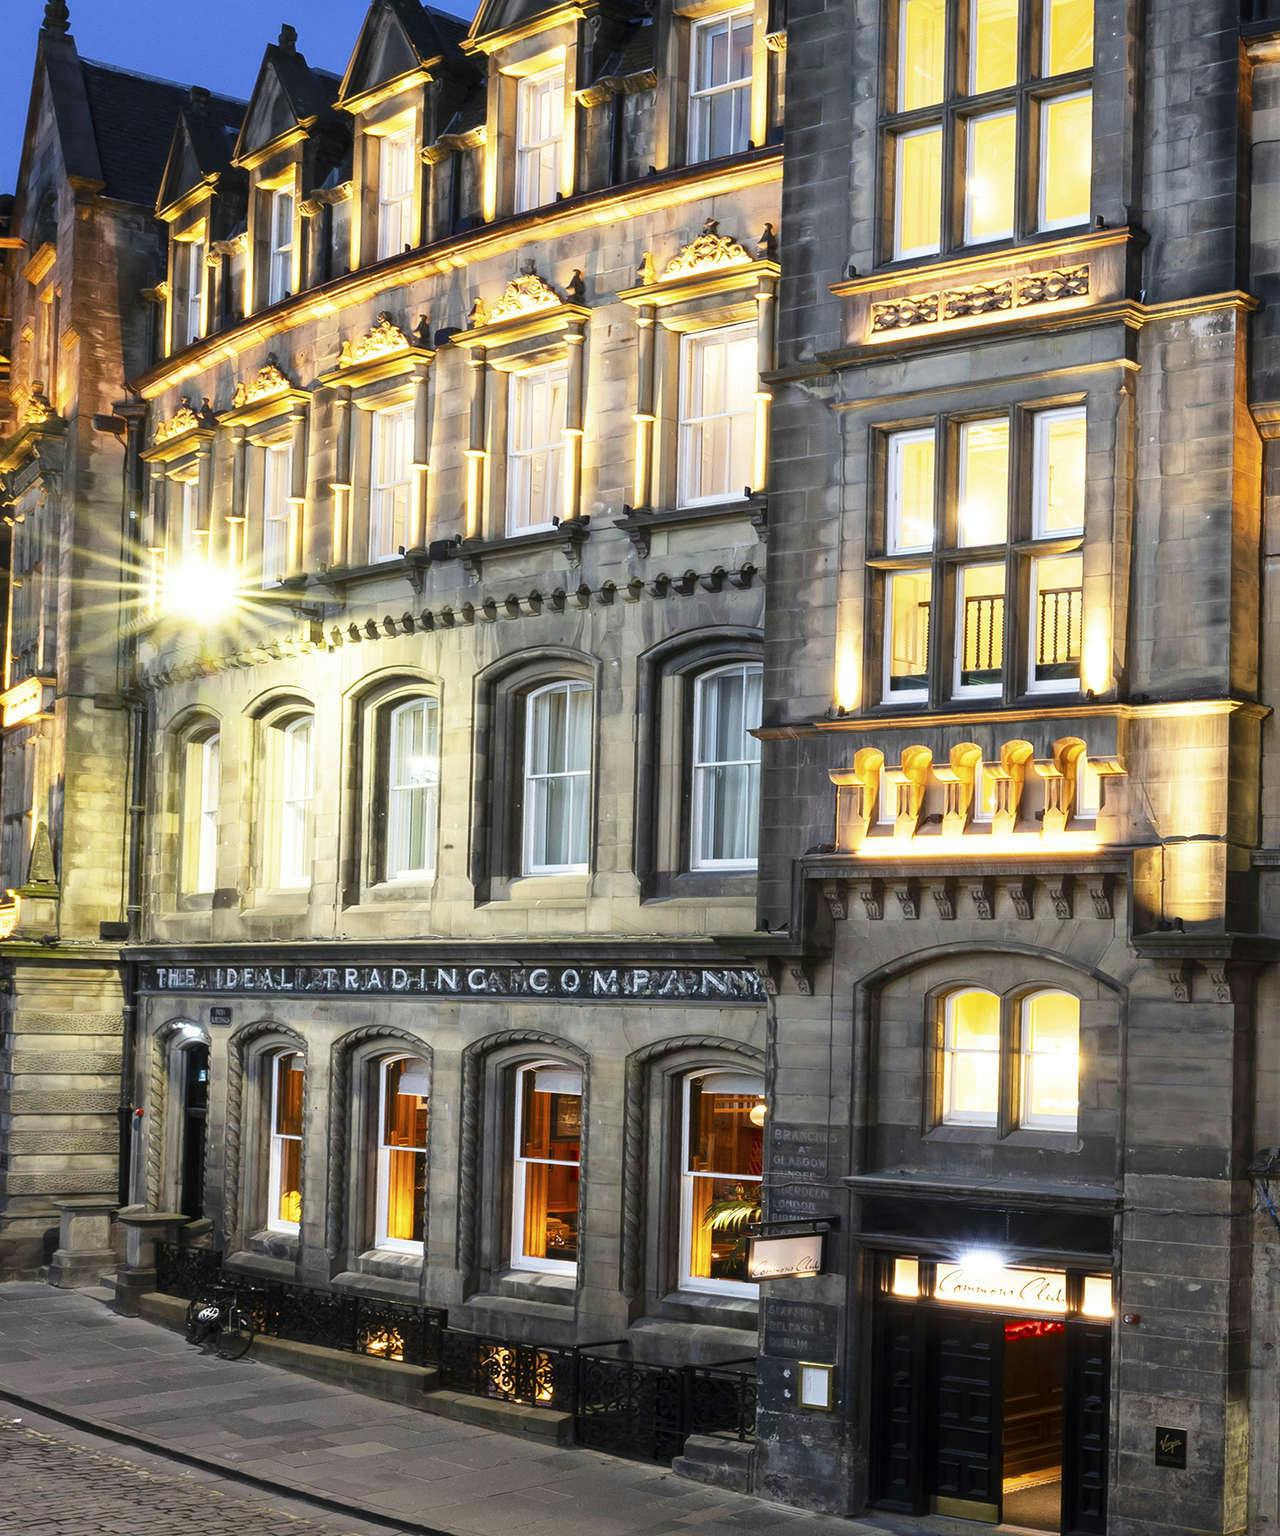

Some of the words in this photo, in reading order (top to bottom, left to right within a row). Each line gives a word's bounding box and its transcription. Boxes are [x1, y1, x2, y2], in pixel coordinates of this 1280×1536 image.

[156, 968, 196, 988] THE
[215, 968, 293, 990] IDEAL
[322, 968, 489, 991] TRADING
[529, 968, 761, 994] COMPANY
[773, 1155, 825, 1169] GLASGOW
[772, 1199, 817, 1210] LONDON
[795, 1256, 820, 1272] Club
[939, 1269, 1014, 1297] Commons
[1018, 1277, 1065, 1303] Club
